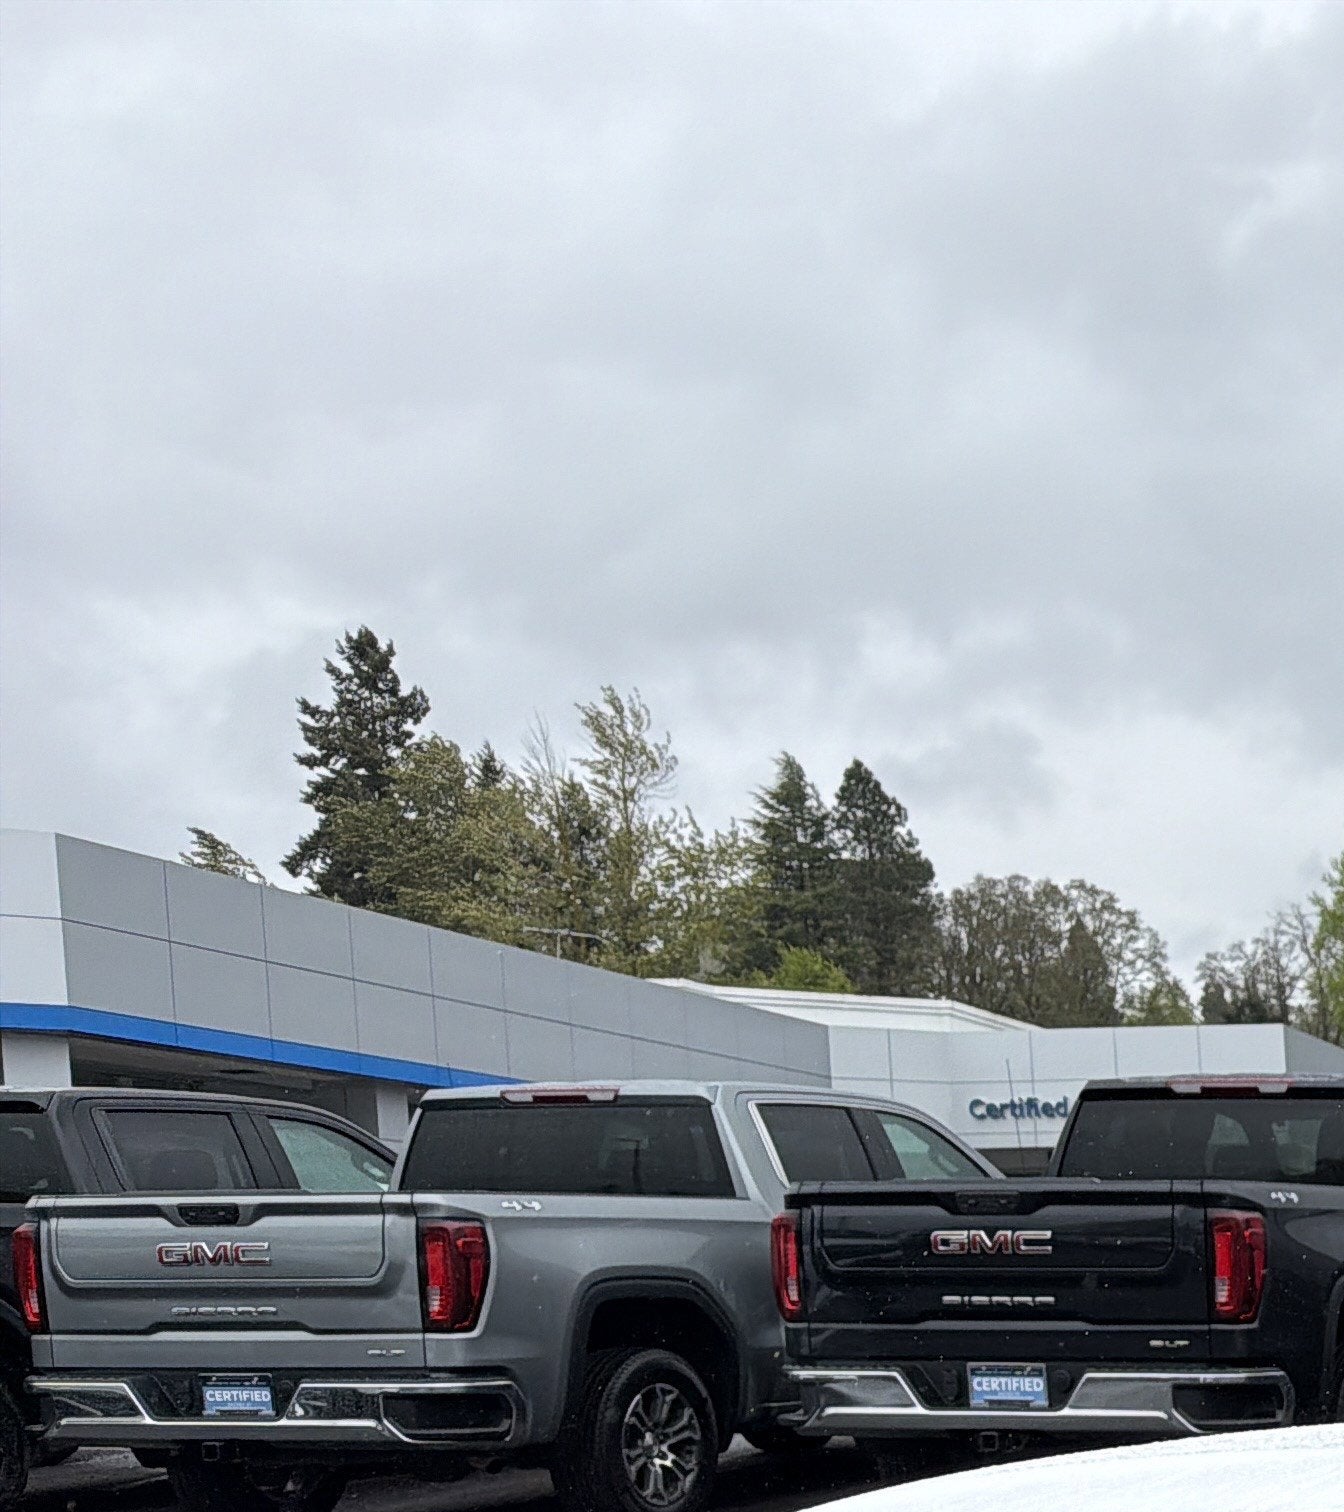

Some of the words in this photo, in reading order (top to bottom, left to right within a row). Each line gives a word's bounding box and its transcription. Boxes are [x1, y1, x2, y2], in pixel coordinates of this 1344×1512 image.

[969, 1096, 1069, 1120] Certified
[156, 1242, 270, 1266] GMC
[929, 1230, 1052, 1255] GMC
[972, 1376, 1044, 1391] CERTIFIED
[205, 1390, 271, 1402] CERTIFIED
